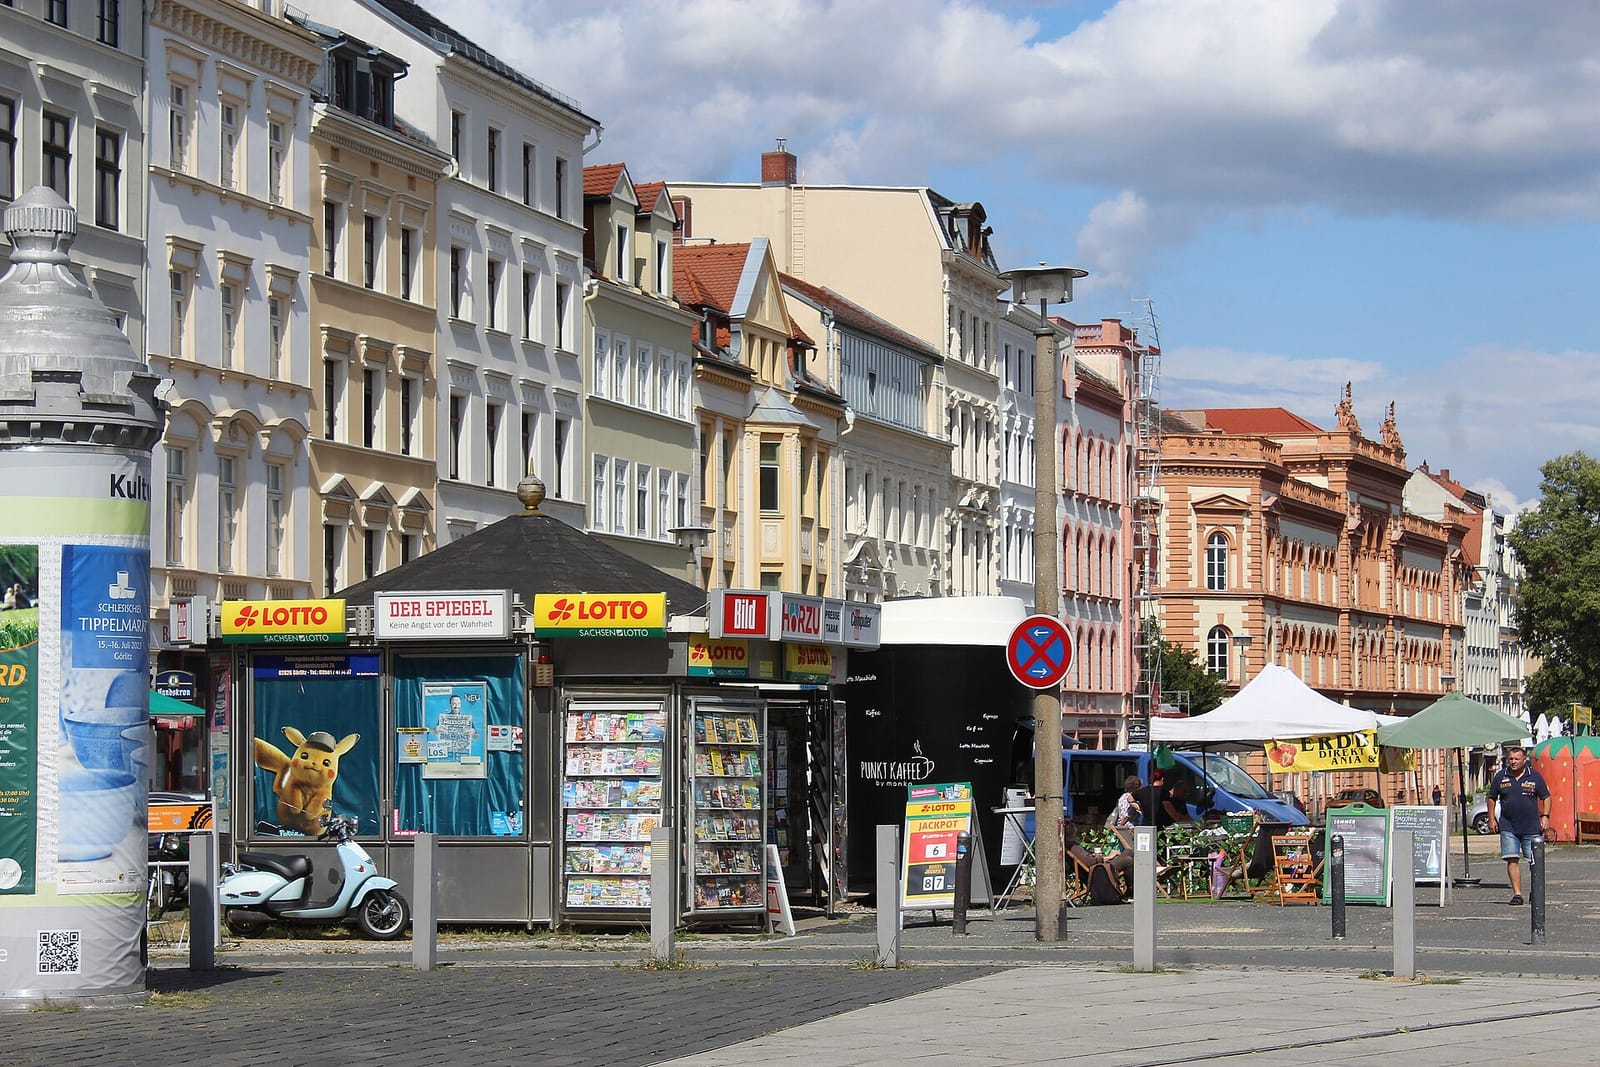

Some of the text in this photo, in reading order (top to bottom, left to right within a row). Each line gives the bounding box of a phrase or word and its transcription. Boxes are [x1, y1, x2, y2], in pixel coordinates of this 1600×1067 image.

[390, 600, 493, 617] DER SPIEGEL
[578, 600, 648, 620] LOTTO
[734, 598, 757, 630] Bild
[263, 606, 328, 626] LOTTO
[825, 610, 840, 621] PRESSE
[389, 621, 409, 630] Keine
[411, 621, 431, 631] Angst
[446, 620, 458, 629] der
[460, 620, 493, 629] Wahrheit
[264, 634, 329, 643] SACHSEN LOTTO
[579, 628, 649, 637] SACHSEN LOTTO
[708, 645, 746, 661] LOTTO
[1319, 747, 1364, 759] DIREKT
[1331, 754, 1377, 766] ANIA &
[860, 761, 921, 780] PUNKT KAFFEE
[931, 804, 956, 812] LOTTO
[918, 820, 959, 832] JACKPOT
[932, 845, 940, 856] 6
